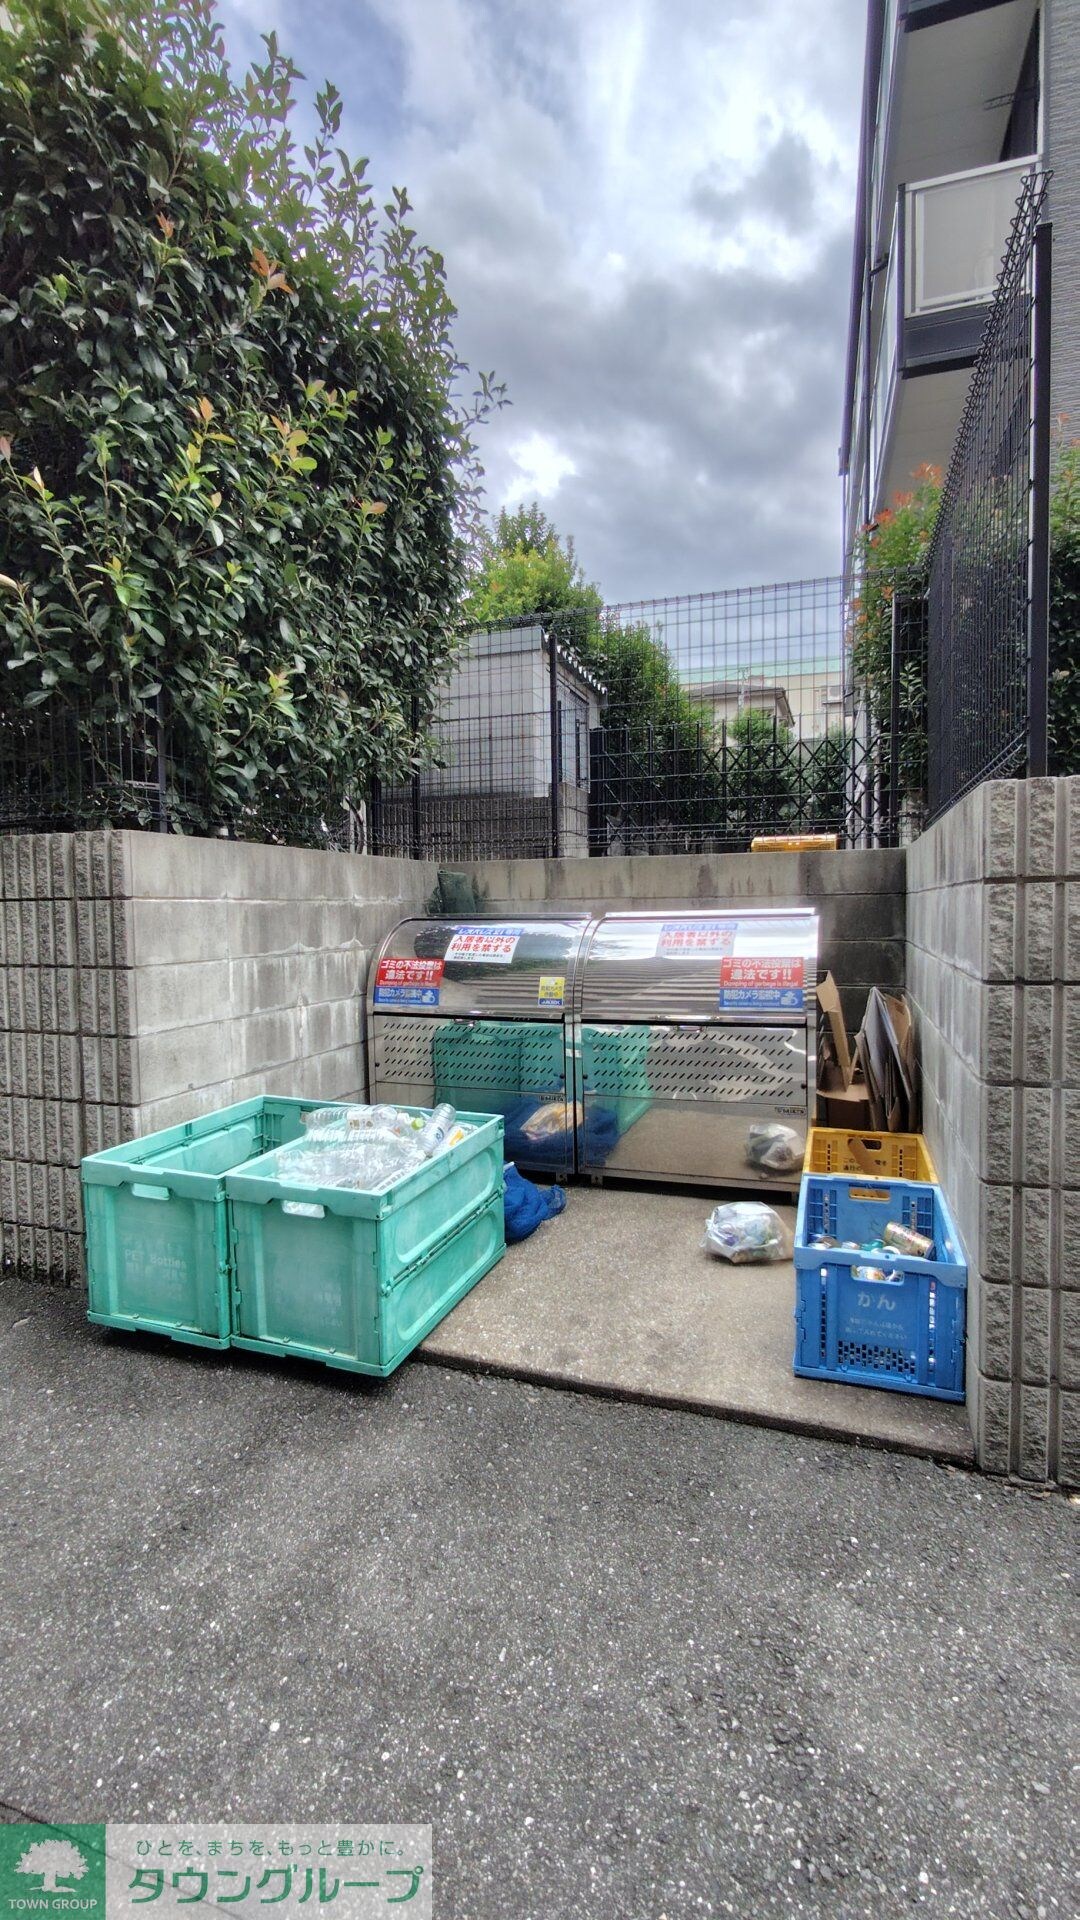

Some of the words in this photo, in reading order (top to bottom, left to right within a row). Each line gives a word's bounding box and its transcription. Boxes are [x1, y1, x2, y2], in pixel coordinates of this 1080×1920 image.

[454, 935, 515, 944] 入居者以外の
[451, 943, 511, 953] 利用を禁する
[381, 959, 442, 970] ゴミの不法投棄は
[723, 958, 801, 969] ゴミの不法投棄は
[723, 980, 748, 988] Dumping
[857, 1291, 896, 1311] かん
